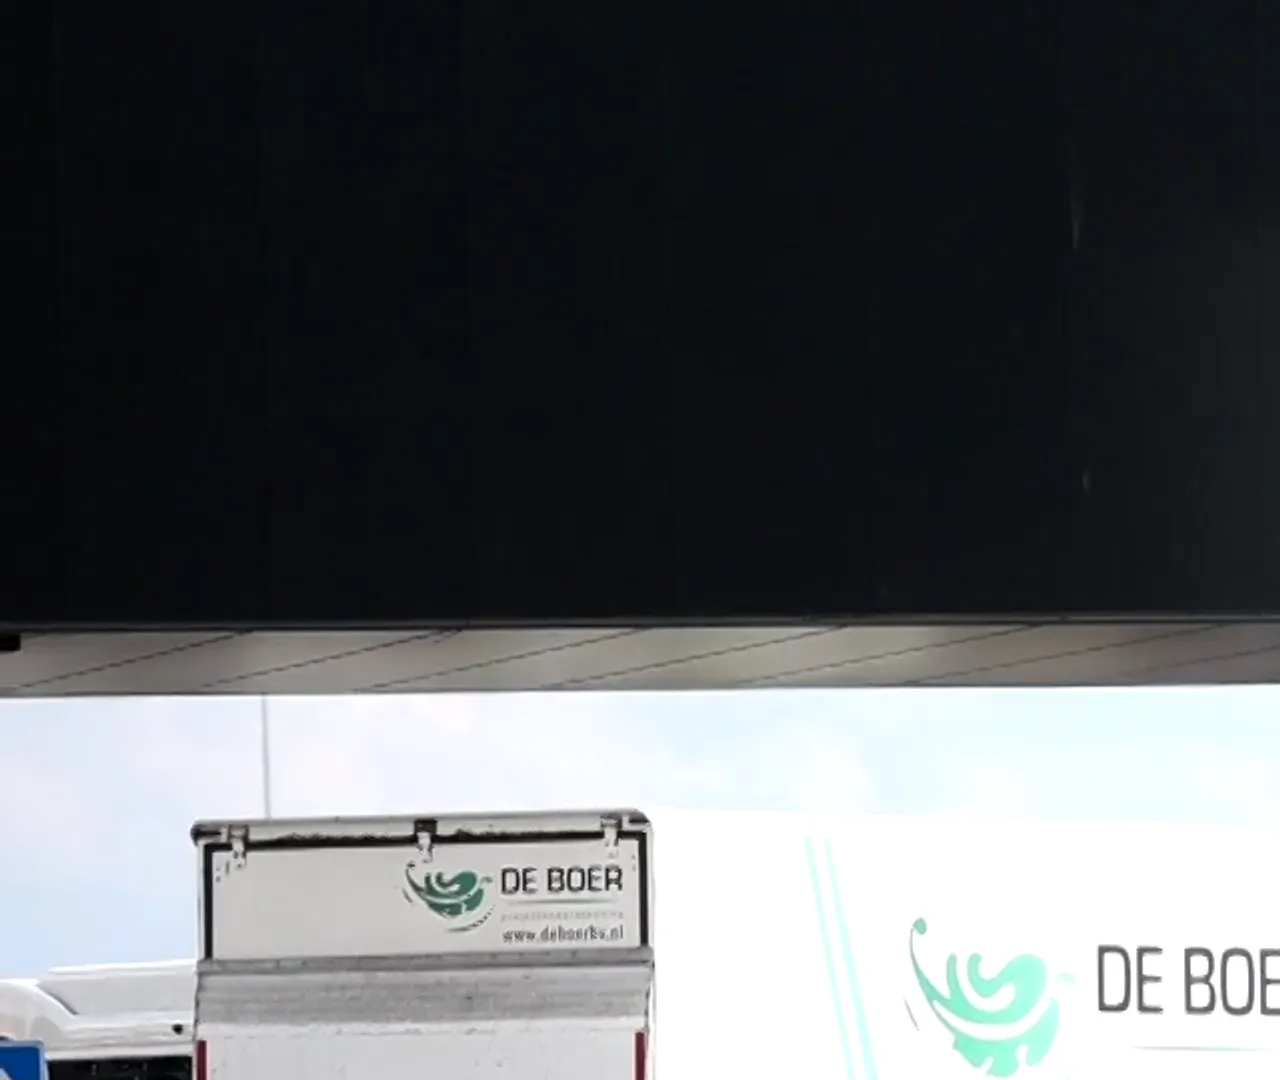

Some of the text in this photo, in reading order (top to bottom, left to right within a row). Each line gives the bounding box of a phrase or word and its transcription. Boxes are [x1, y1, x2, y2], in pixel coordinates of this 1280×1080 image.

[501, 865, 623, 894] DE BOER
[1096, 944, 1165, 1015] DE
